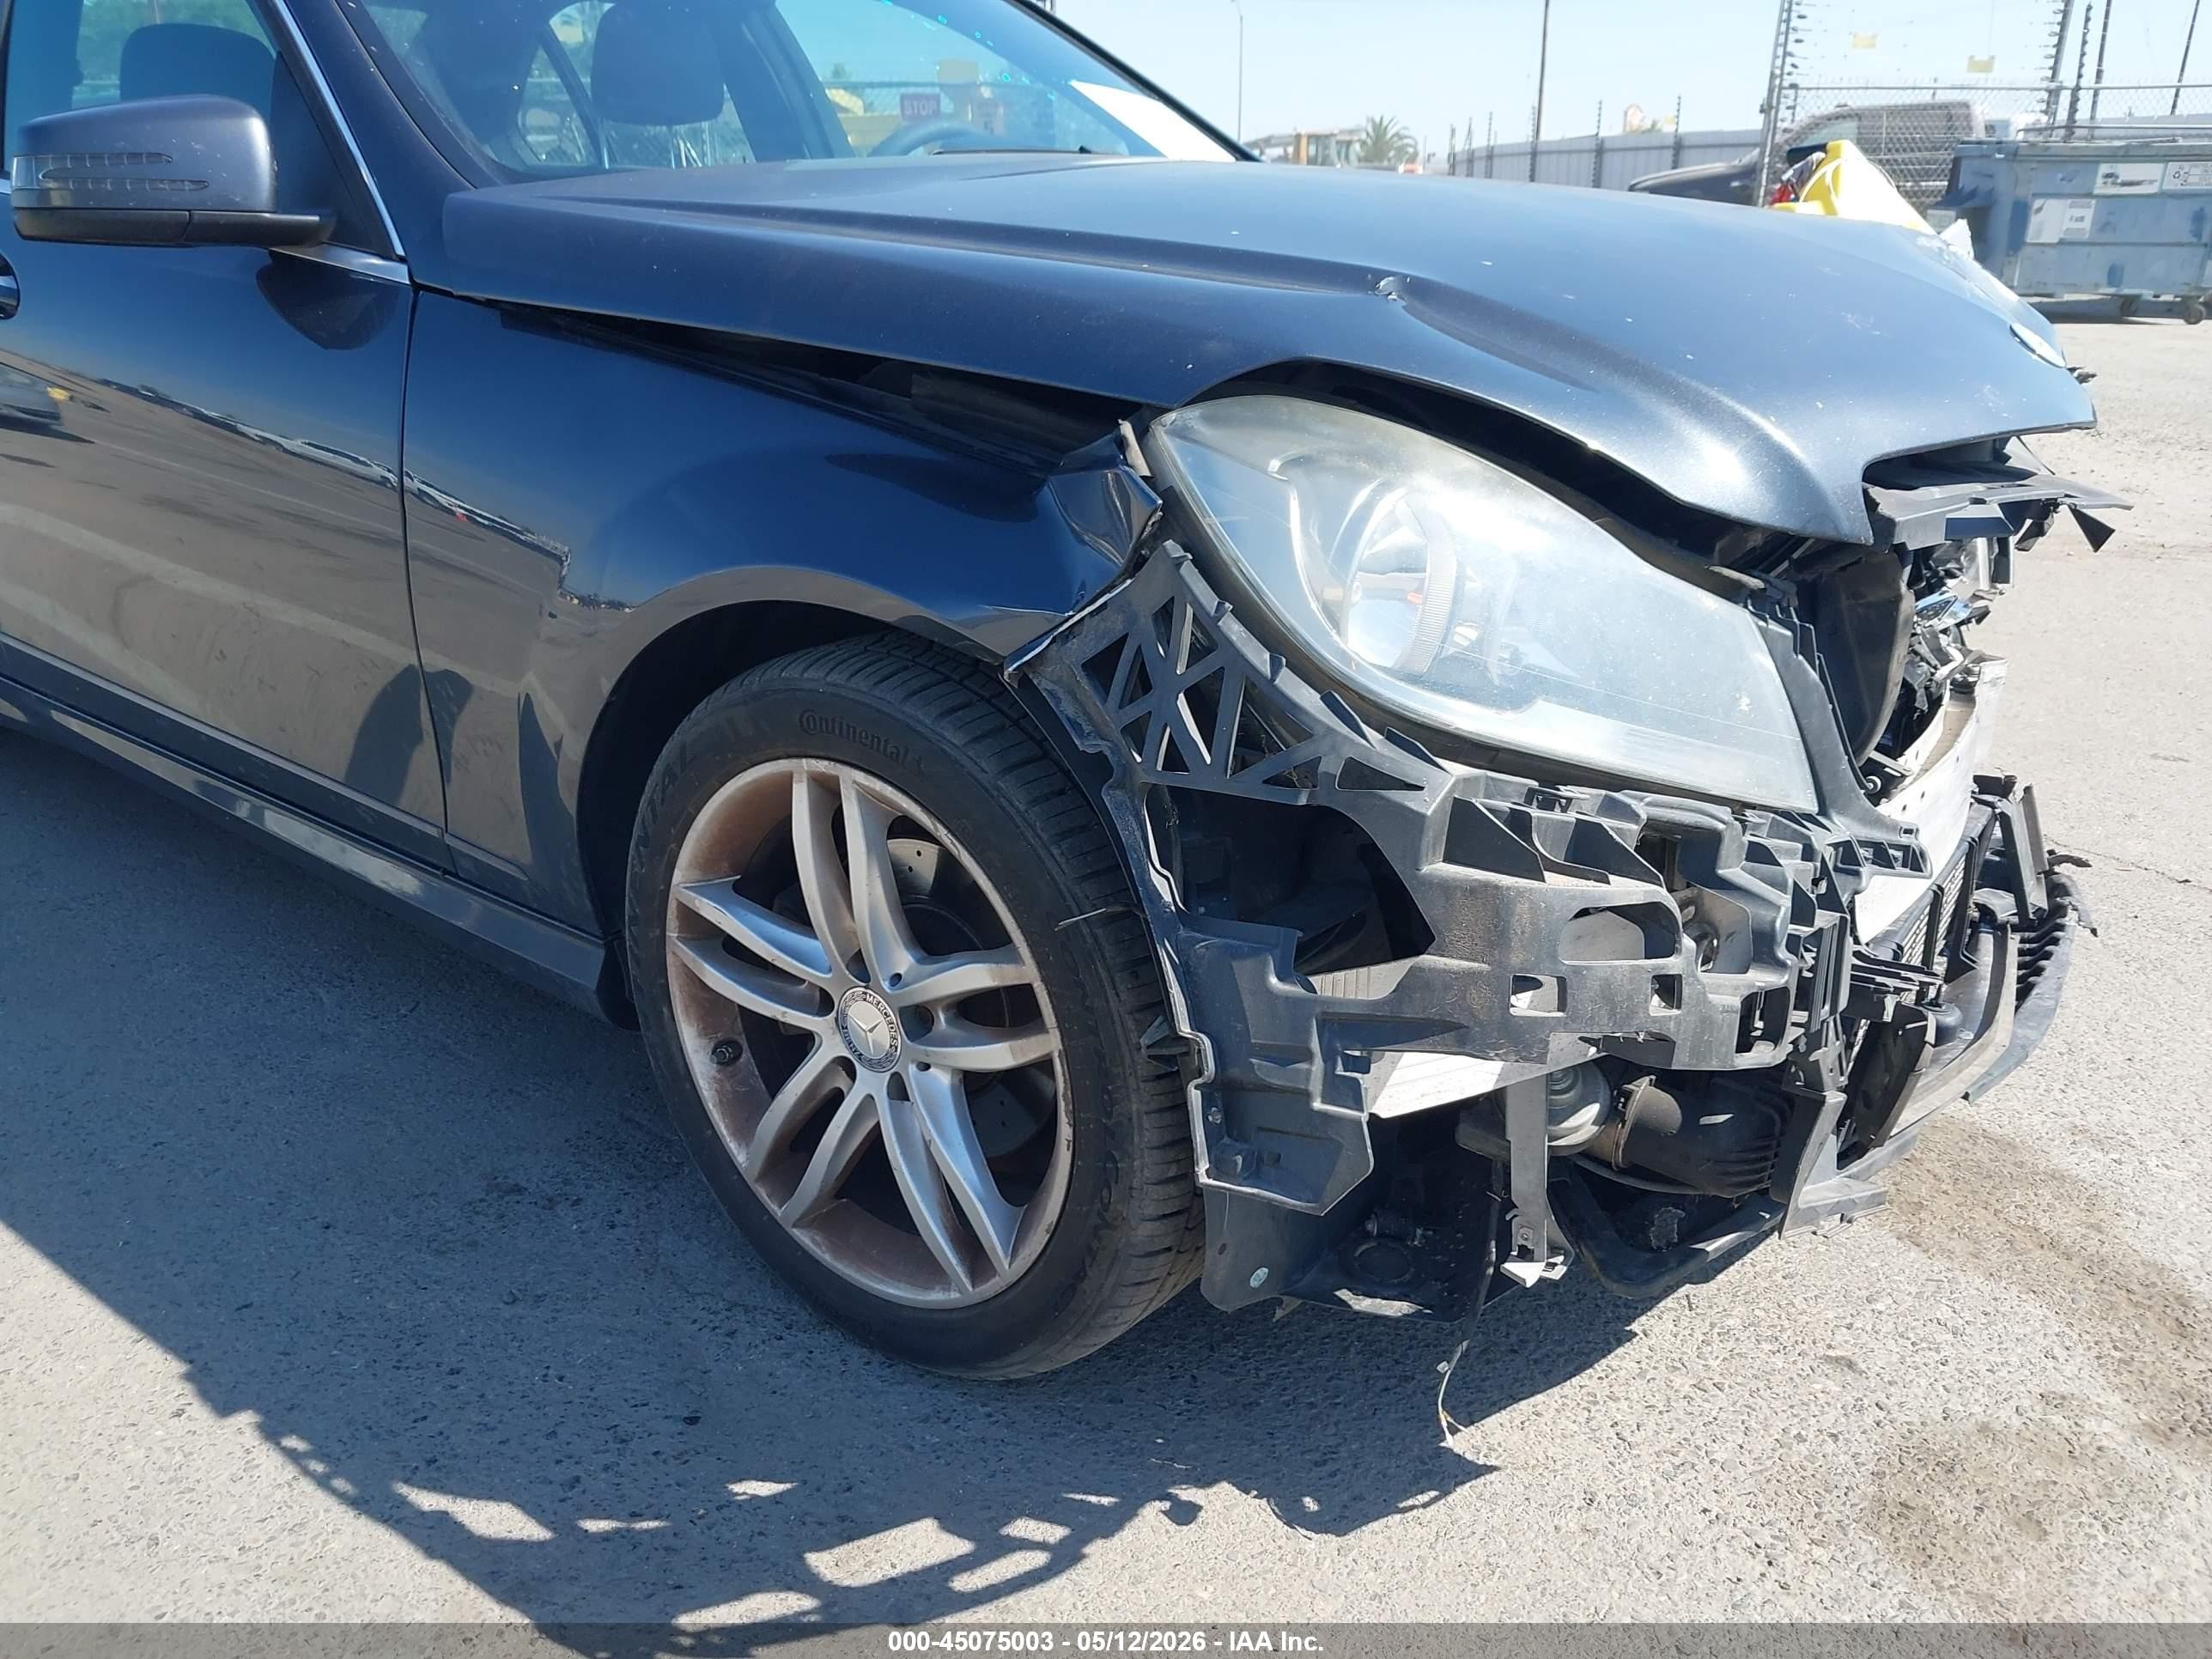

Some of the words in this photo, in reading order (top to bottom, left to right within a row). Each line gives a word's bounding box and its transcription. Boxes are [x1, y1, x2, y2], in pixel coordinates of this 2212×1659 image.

[903, 99, 937, 116] STOP
[798, 709, 910, 769] Continental
[866, 993, 898, 1048] MERCEDES
